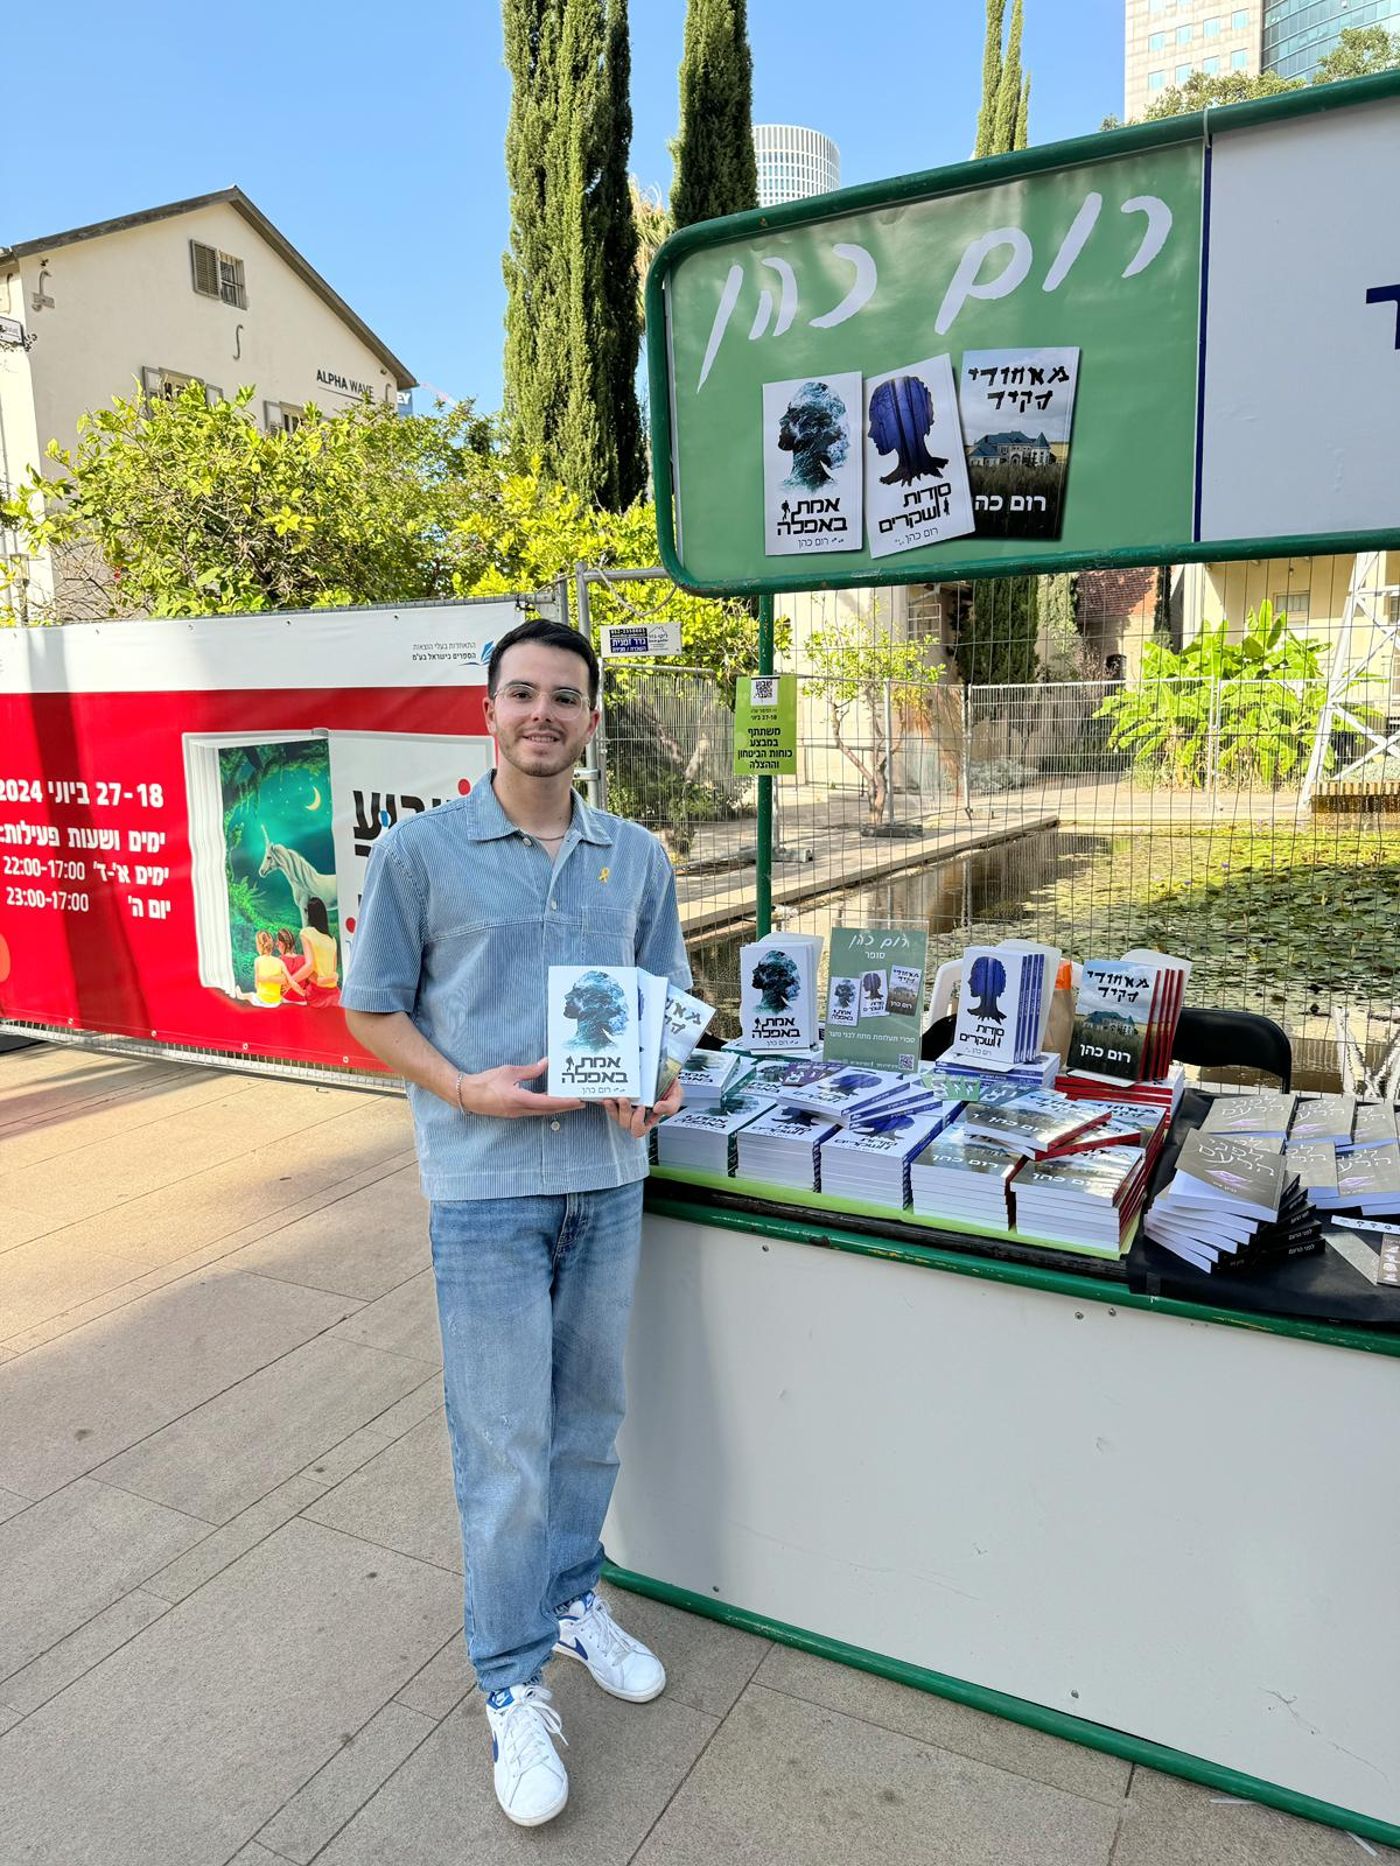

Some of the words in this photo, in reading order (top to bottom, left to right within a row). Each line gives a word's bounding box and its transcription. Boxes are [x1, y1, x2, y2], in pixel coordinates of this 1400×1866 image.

[934, 191, 1173, 335] רום
[696, 243, 877, 394] כהן
[316, 369, 348, 389] ALPHA
[968, 365, 1070, 387] מאחורי
[987, 390, 1053, 413] הקיר
[903, 482, 952, 509] סודות
[974, 494, 1003, 511] כה
[1009, 494, 1046, 511] רום
[794, 497, 841, 514] אמת
[777, 516, 848, 535] באפלה
[878, 504, 940, 534] ושקרים
[905, 530, 921, 544] כהן
[924, 526, 938, 538] רום
[798, 538, 813, 550] כהן
[815, 538, 829, 547] רום
[612, 638, 632, 646] זמנית
[632, 637, 647, 645] גדר
[748, 728, 781, 738] משתתף
[749, 739, 779, 747] במבצע
[737, 749, 767, 760] הביטחון
[769, 749, 793, 758] כוחות
[749, 760, 780, 769] וההצלה
[48, 780, 90, 805] ביוני
[68, 827, 120, 851] ושעות
[128, 831, 166, 853] ימים
[3, 855, 86, 881] 22:00-17:00
[135, 865, 170, 886] ימים
[6, 886, 90, 913] 23:00-17:00
[128, 894, 144, 918] ה'
[148, 898, 172, 920] יום
[848, 933, 875, 949] כהן
[864, 951, 886, 960] סופר
[1087, 970, 1149, 988] מאחורי
[1098, 986, 1139, 1003] הקיר
[761, 1017, 795, 1027] אמת
[752, 1028, 801, 1039] באפלה
[976, 1024, 1005, 1037] סודות
[960, 1033, 997, 1047] ושקרים
[1080, 1043, 1104, 1057] כהן
[1107, 1049, 1131, 1064] רום
[576, 1057, 621, 1069] אמת
[562, 1070, 629, 1084] באפלה
[1209, 1138, 1264, 1162] לפני
[932, 1154, 964, 1163] כהן
[968, 1159, 999, 1169] רום
[1198, 1144, 1275, 1176] הרעם
